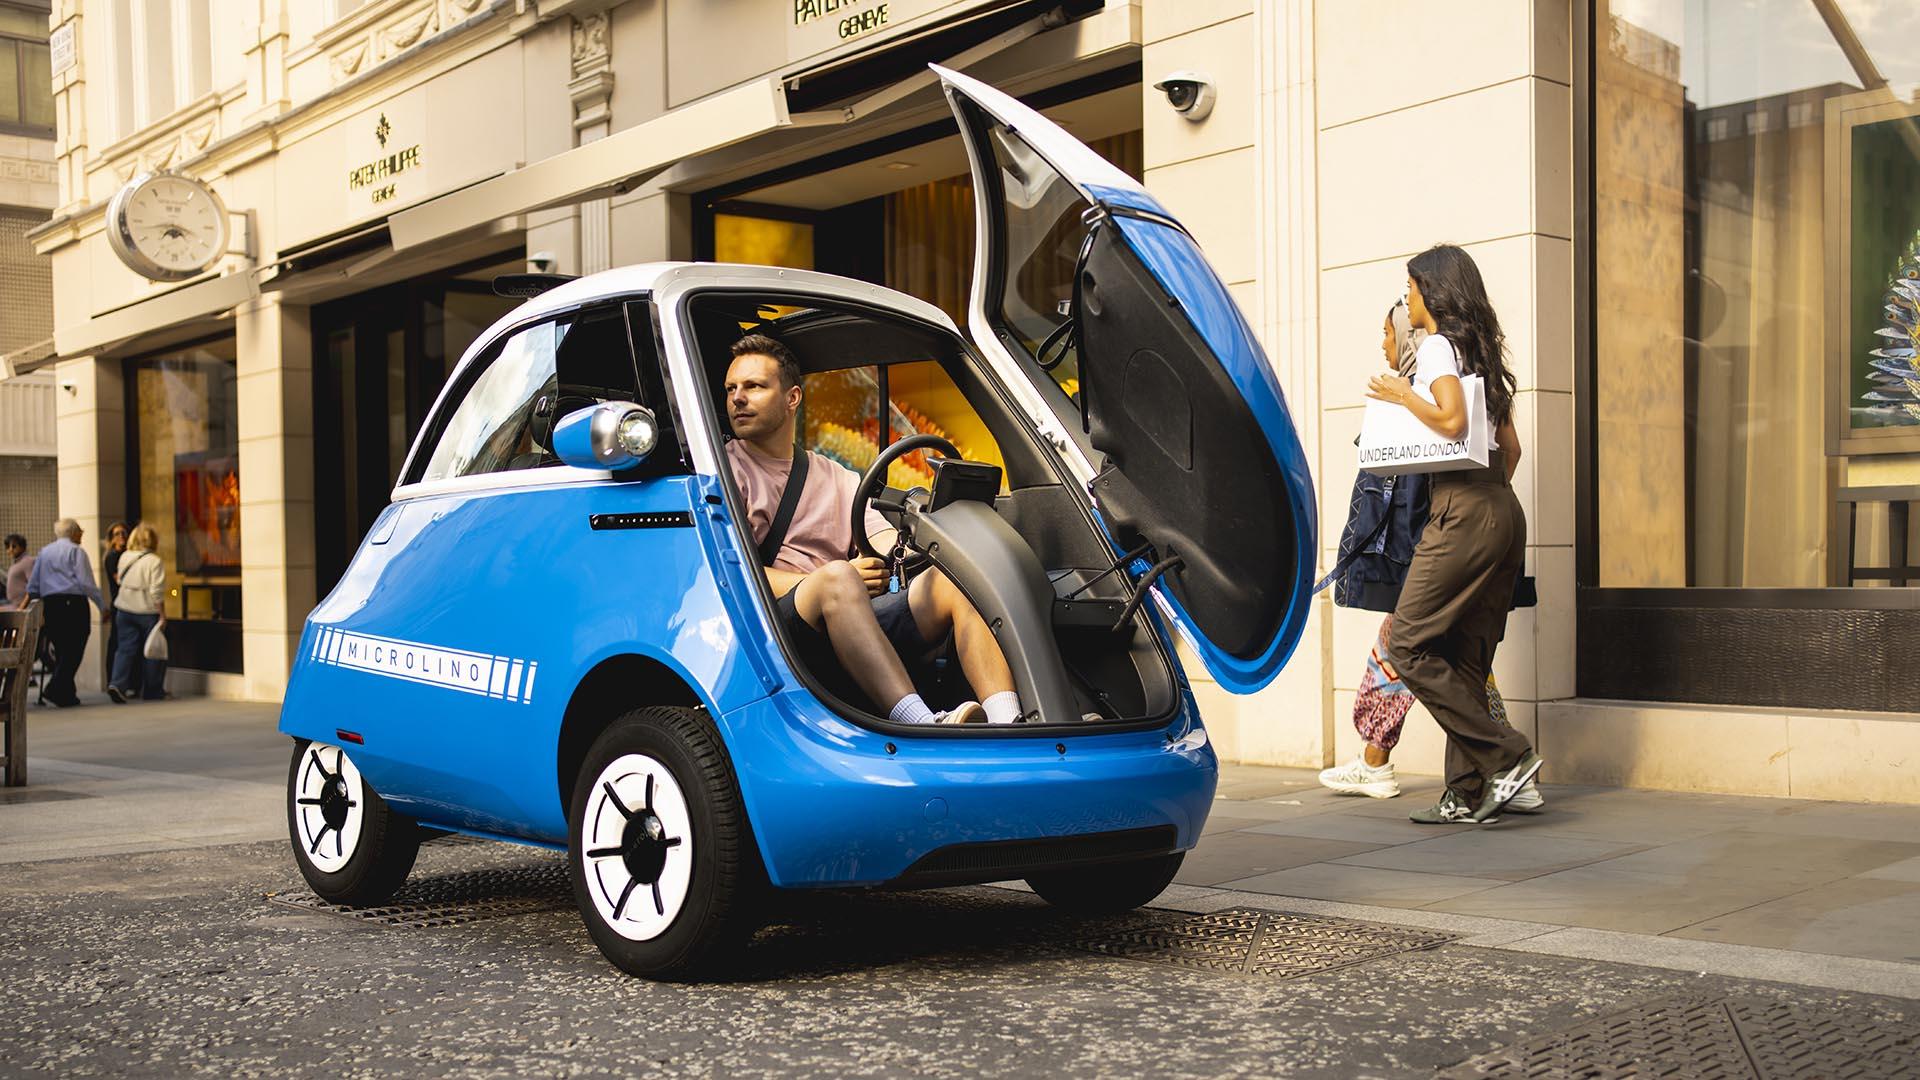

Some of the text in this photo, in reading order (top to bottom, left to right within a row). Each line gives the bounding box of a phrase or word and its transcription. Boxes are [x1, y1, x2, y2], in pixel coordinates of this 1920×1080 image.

[794, 0, 848, 24] PAT
[839, 3, 888, 38] GENEVE
[1423, 440, 1468, 456] LONDON
[349, 642, 479, 682] MICROLINO
